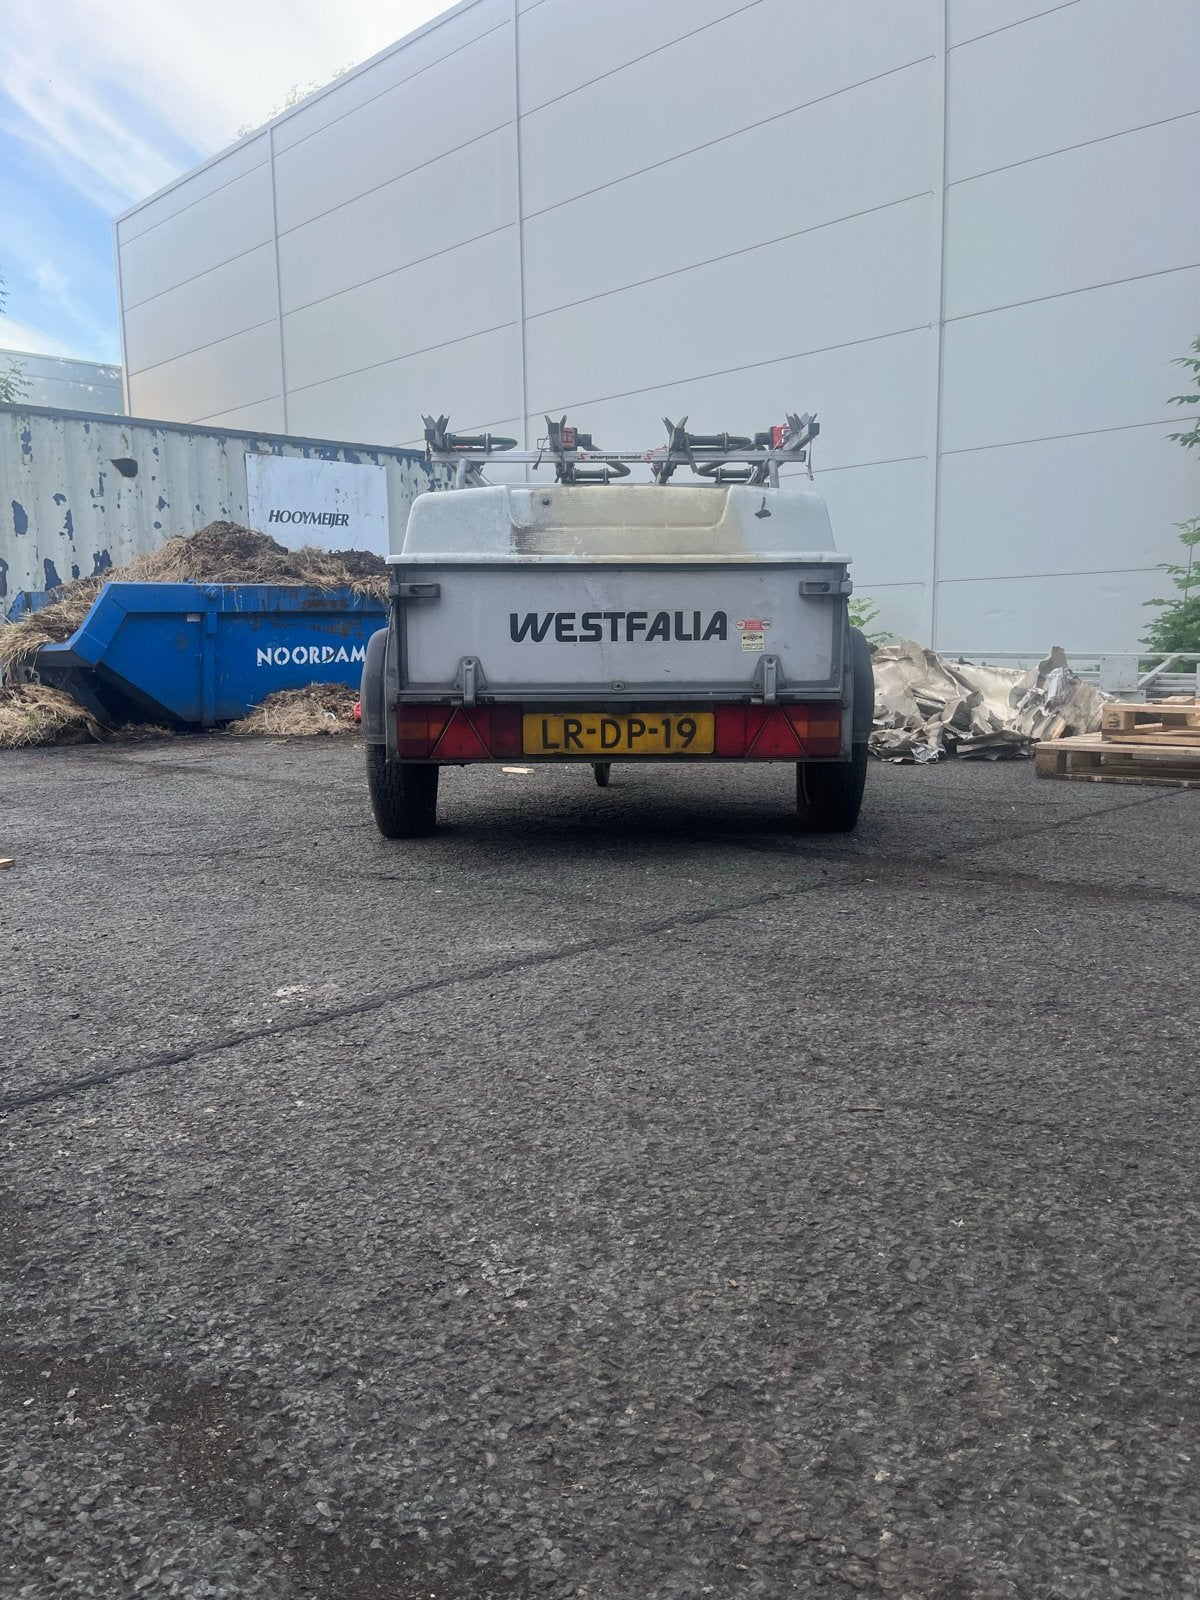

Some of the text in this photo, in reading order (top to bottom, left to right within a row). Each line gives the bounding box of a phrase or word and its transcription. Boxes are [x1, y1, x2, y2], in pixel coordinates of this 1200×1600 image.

[268, 509, 350, 528] HOOYMEIJER
[509, 610, 728, 643] WESTFALIA
[256, 645, 366, 667] NOORDAM
[541, 717, 697, 750] LR-DP-19
